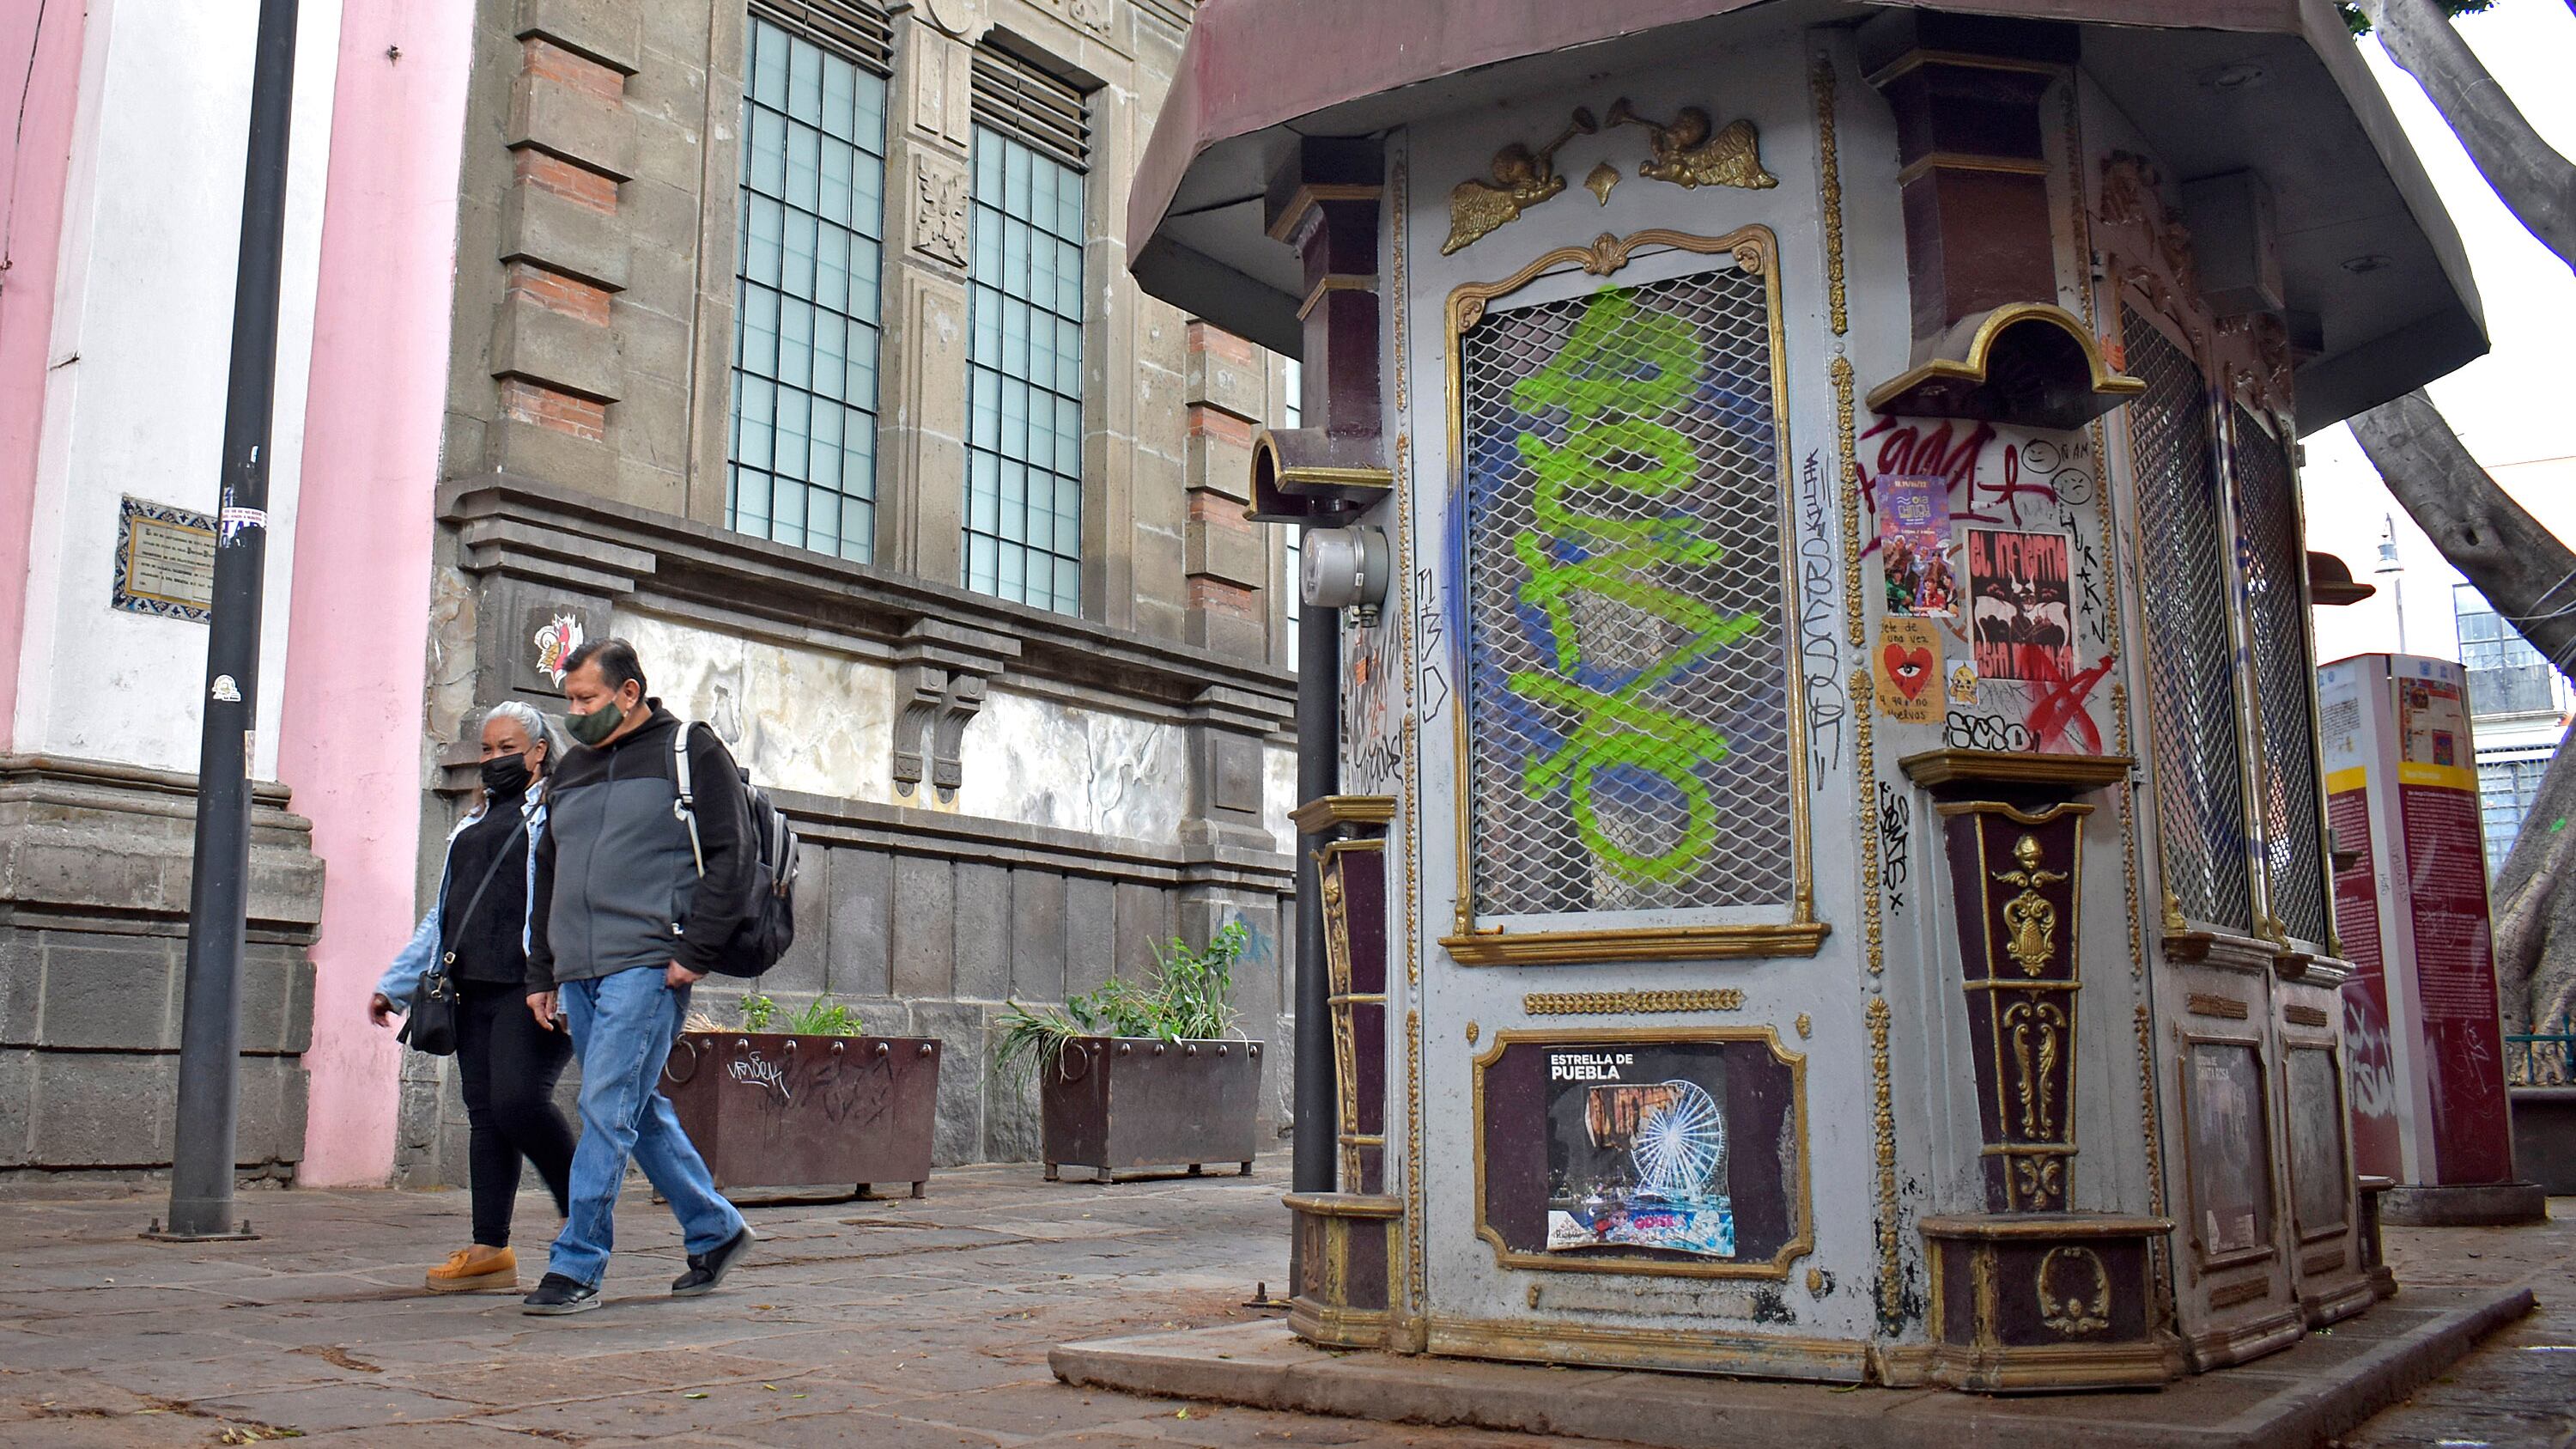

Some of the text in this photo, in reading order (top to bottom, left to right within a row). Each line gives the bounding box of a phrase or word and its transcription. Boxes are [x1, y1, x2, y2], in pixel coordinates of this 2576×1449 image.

[1994, 532, 2068, 583] INFIERNO
[1904, 620, 1917, 632] de
[1887, 635, 1904, 643] una
[1916, 697, 1929, 707] no
[1550, 1053, 1634, 1065] ESTRELLA DE
[1551, 1065, 1621, 1081] PUEBLA
